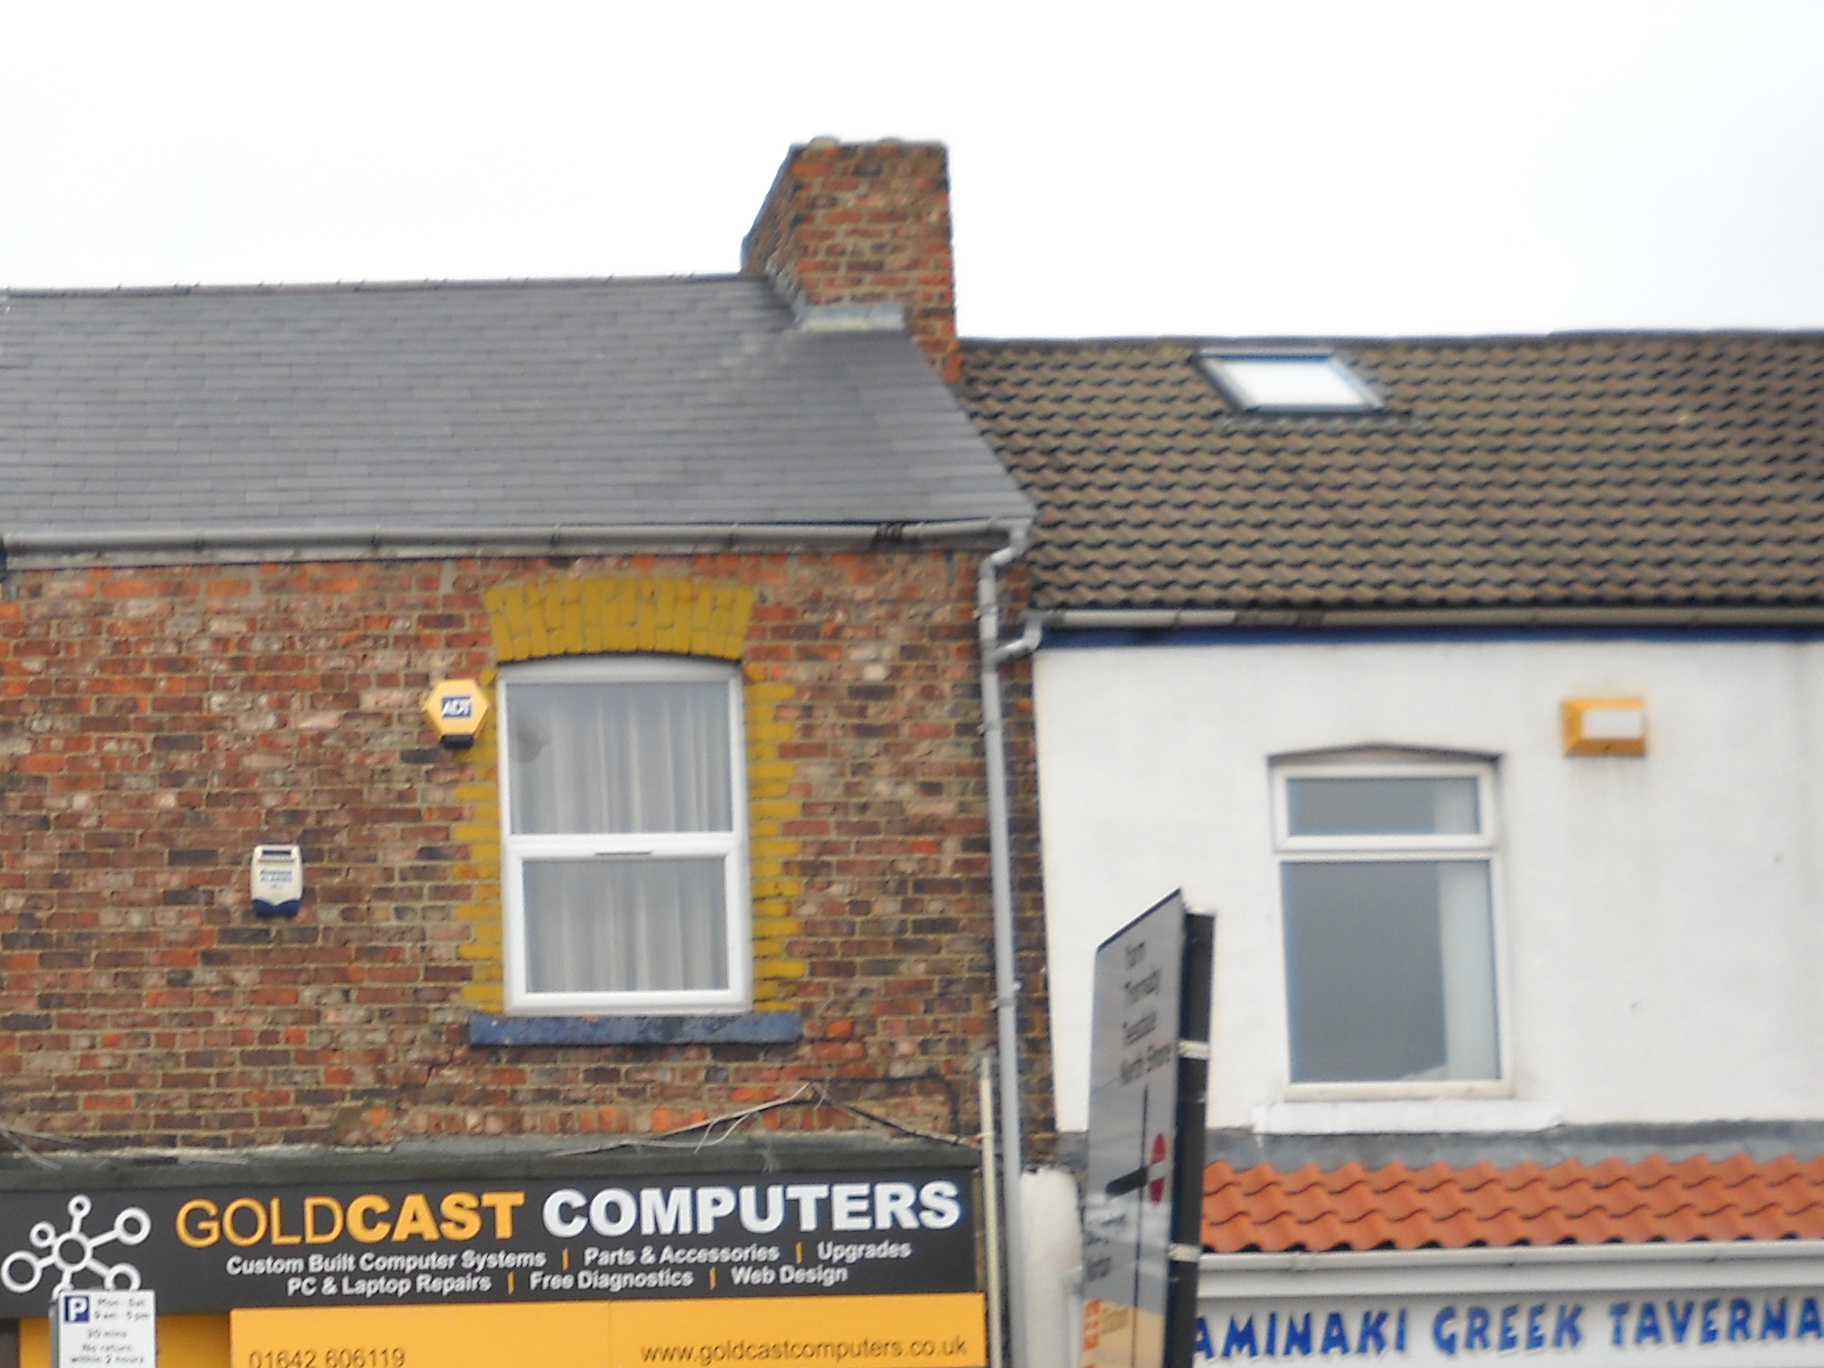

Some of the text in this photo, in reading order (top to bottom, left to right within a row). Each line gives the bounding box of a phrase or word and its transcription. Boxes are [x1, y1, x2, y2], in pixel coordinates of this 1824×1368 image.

[176, 1181, 962, 1248] GOLDCAST COMPUTERS
[227, 1248, 547, 1276] Custom Built Computer Systems
[584, 1243, 780, 1266] Parts & Accessories
[817, 1240, 912, 1264] Upgrades
[287, 1273, 491, 1298] PC & Laptop Repairs
[530, 1268, 694, 1292] Free Diagnostics
[731, 1264, 848, 1287] Web Design
[68, 1298, 87, 1321] P
[1194, 1306, 1407, 1359] AMINAKI
[1433, 1301, 1583, 1356] GREEK
[1609, 1294, 1824, 1345] TAVERNA
[641, 1336, 967, 1365] www.goldcastcomputers.co.uk
